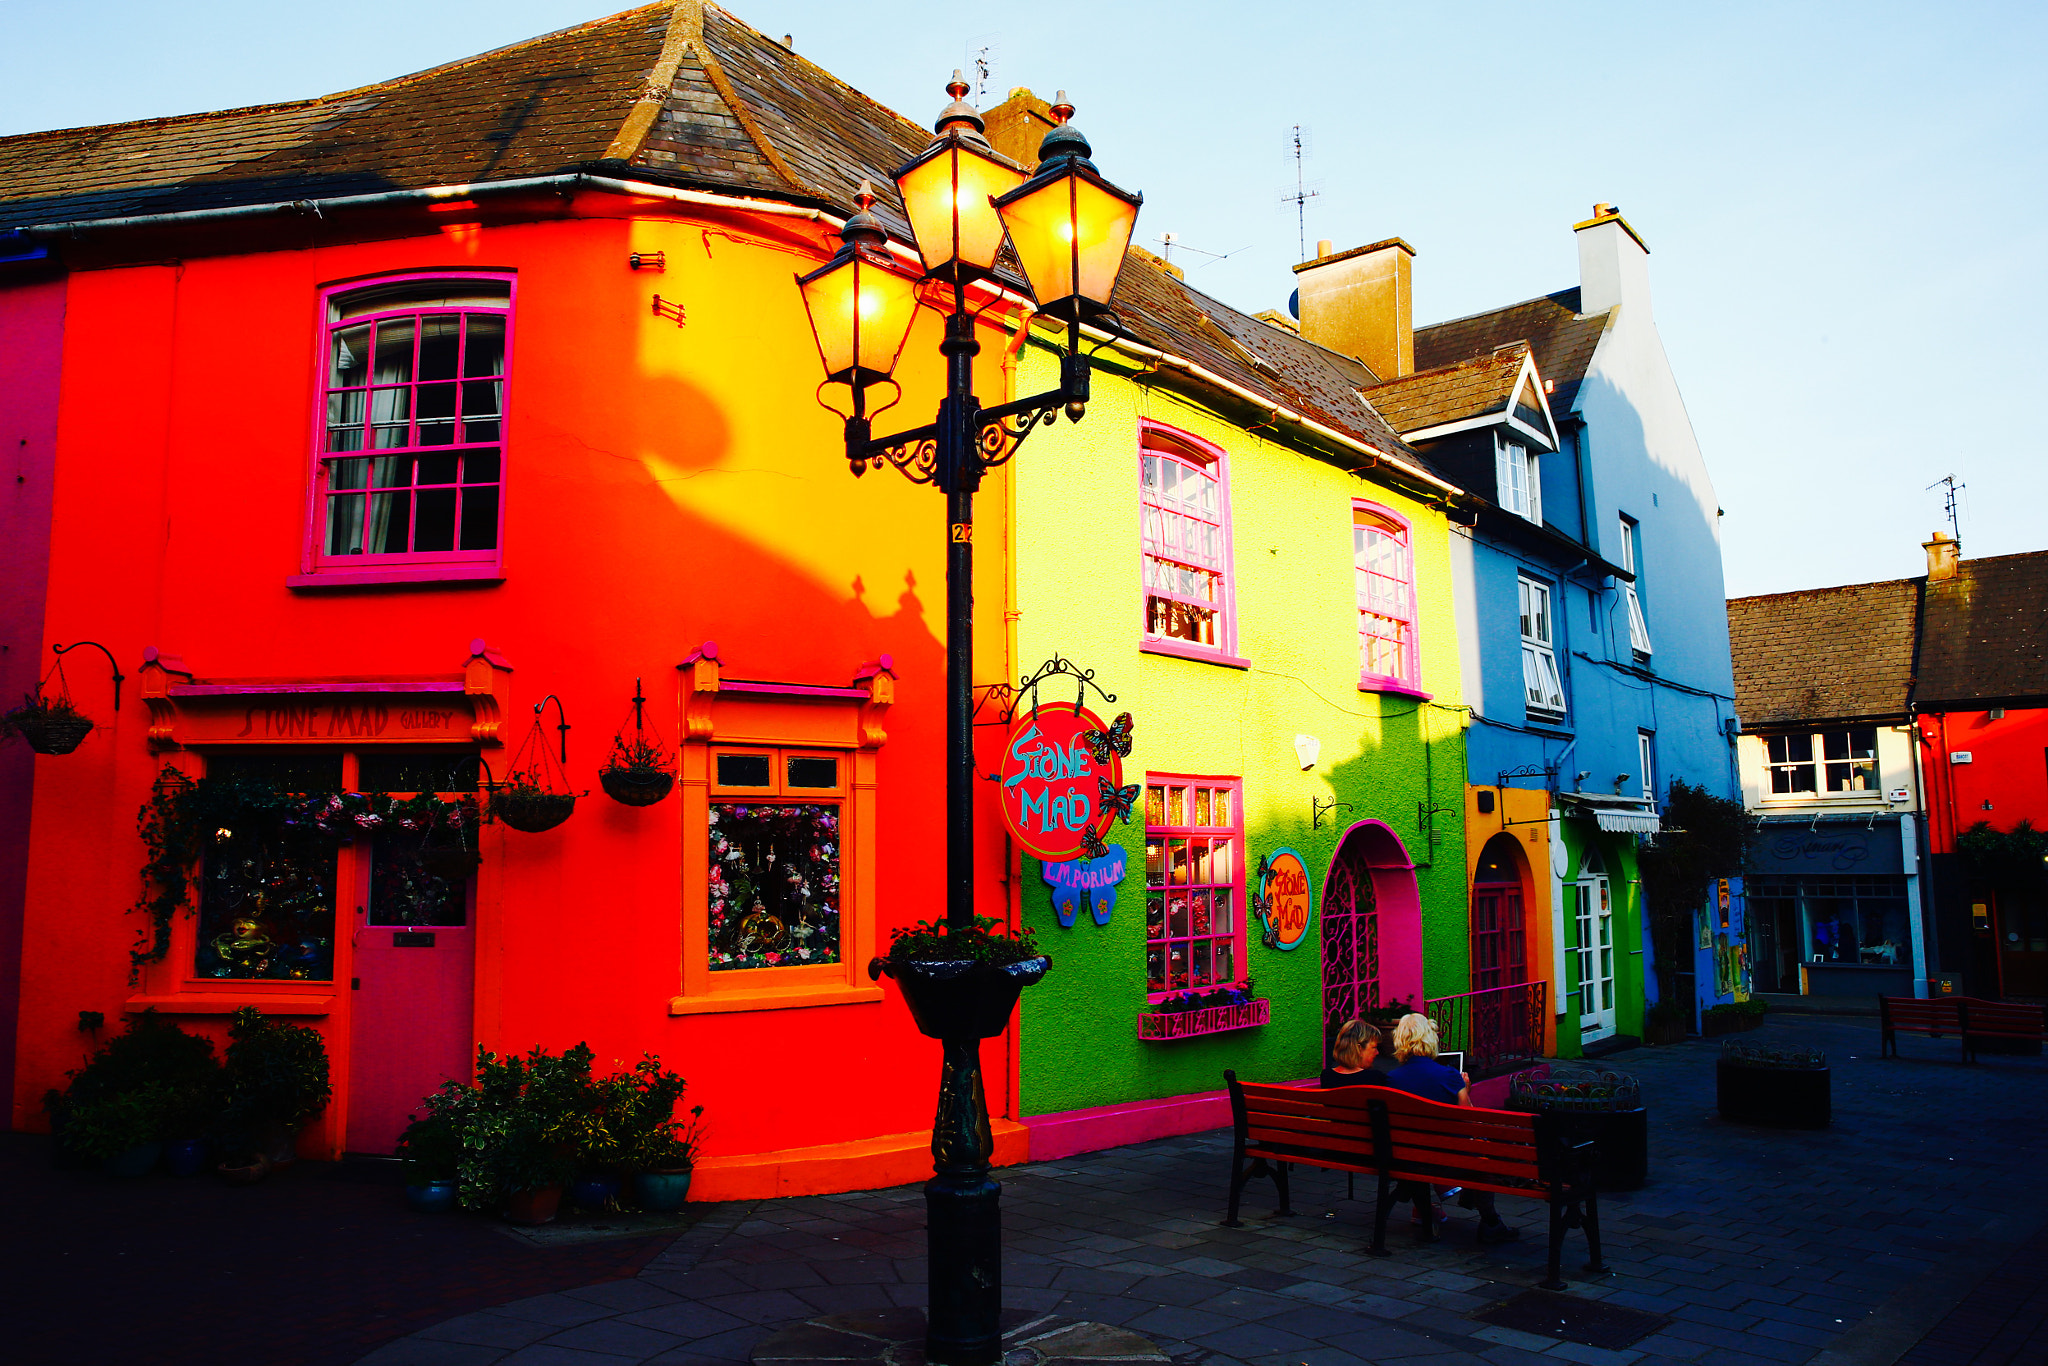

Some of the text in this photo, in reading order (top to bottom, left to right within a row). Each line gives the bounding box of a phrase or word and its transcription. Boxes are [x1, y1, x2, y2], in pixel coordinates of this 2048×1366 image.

[237, 703, 454, 737] STONE MAD GALLERY
[1004, 723, 1092, 798] STONE
[1019, 786, 1090, 834] MAD
[1043, 859, 1126, 889] EMPORIUM
[1275, 868, 1306, 905] STONE
[1277, 898, 1305, 932] MAD
